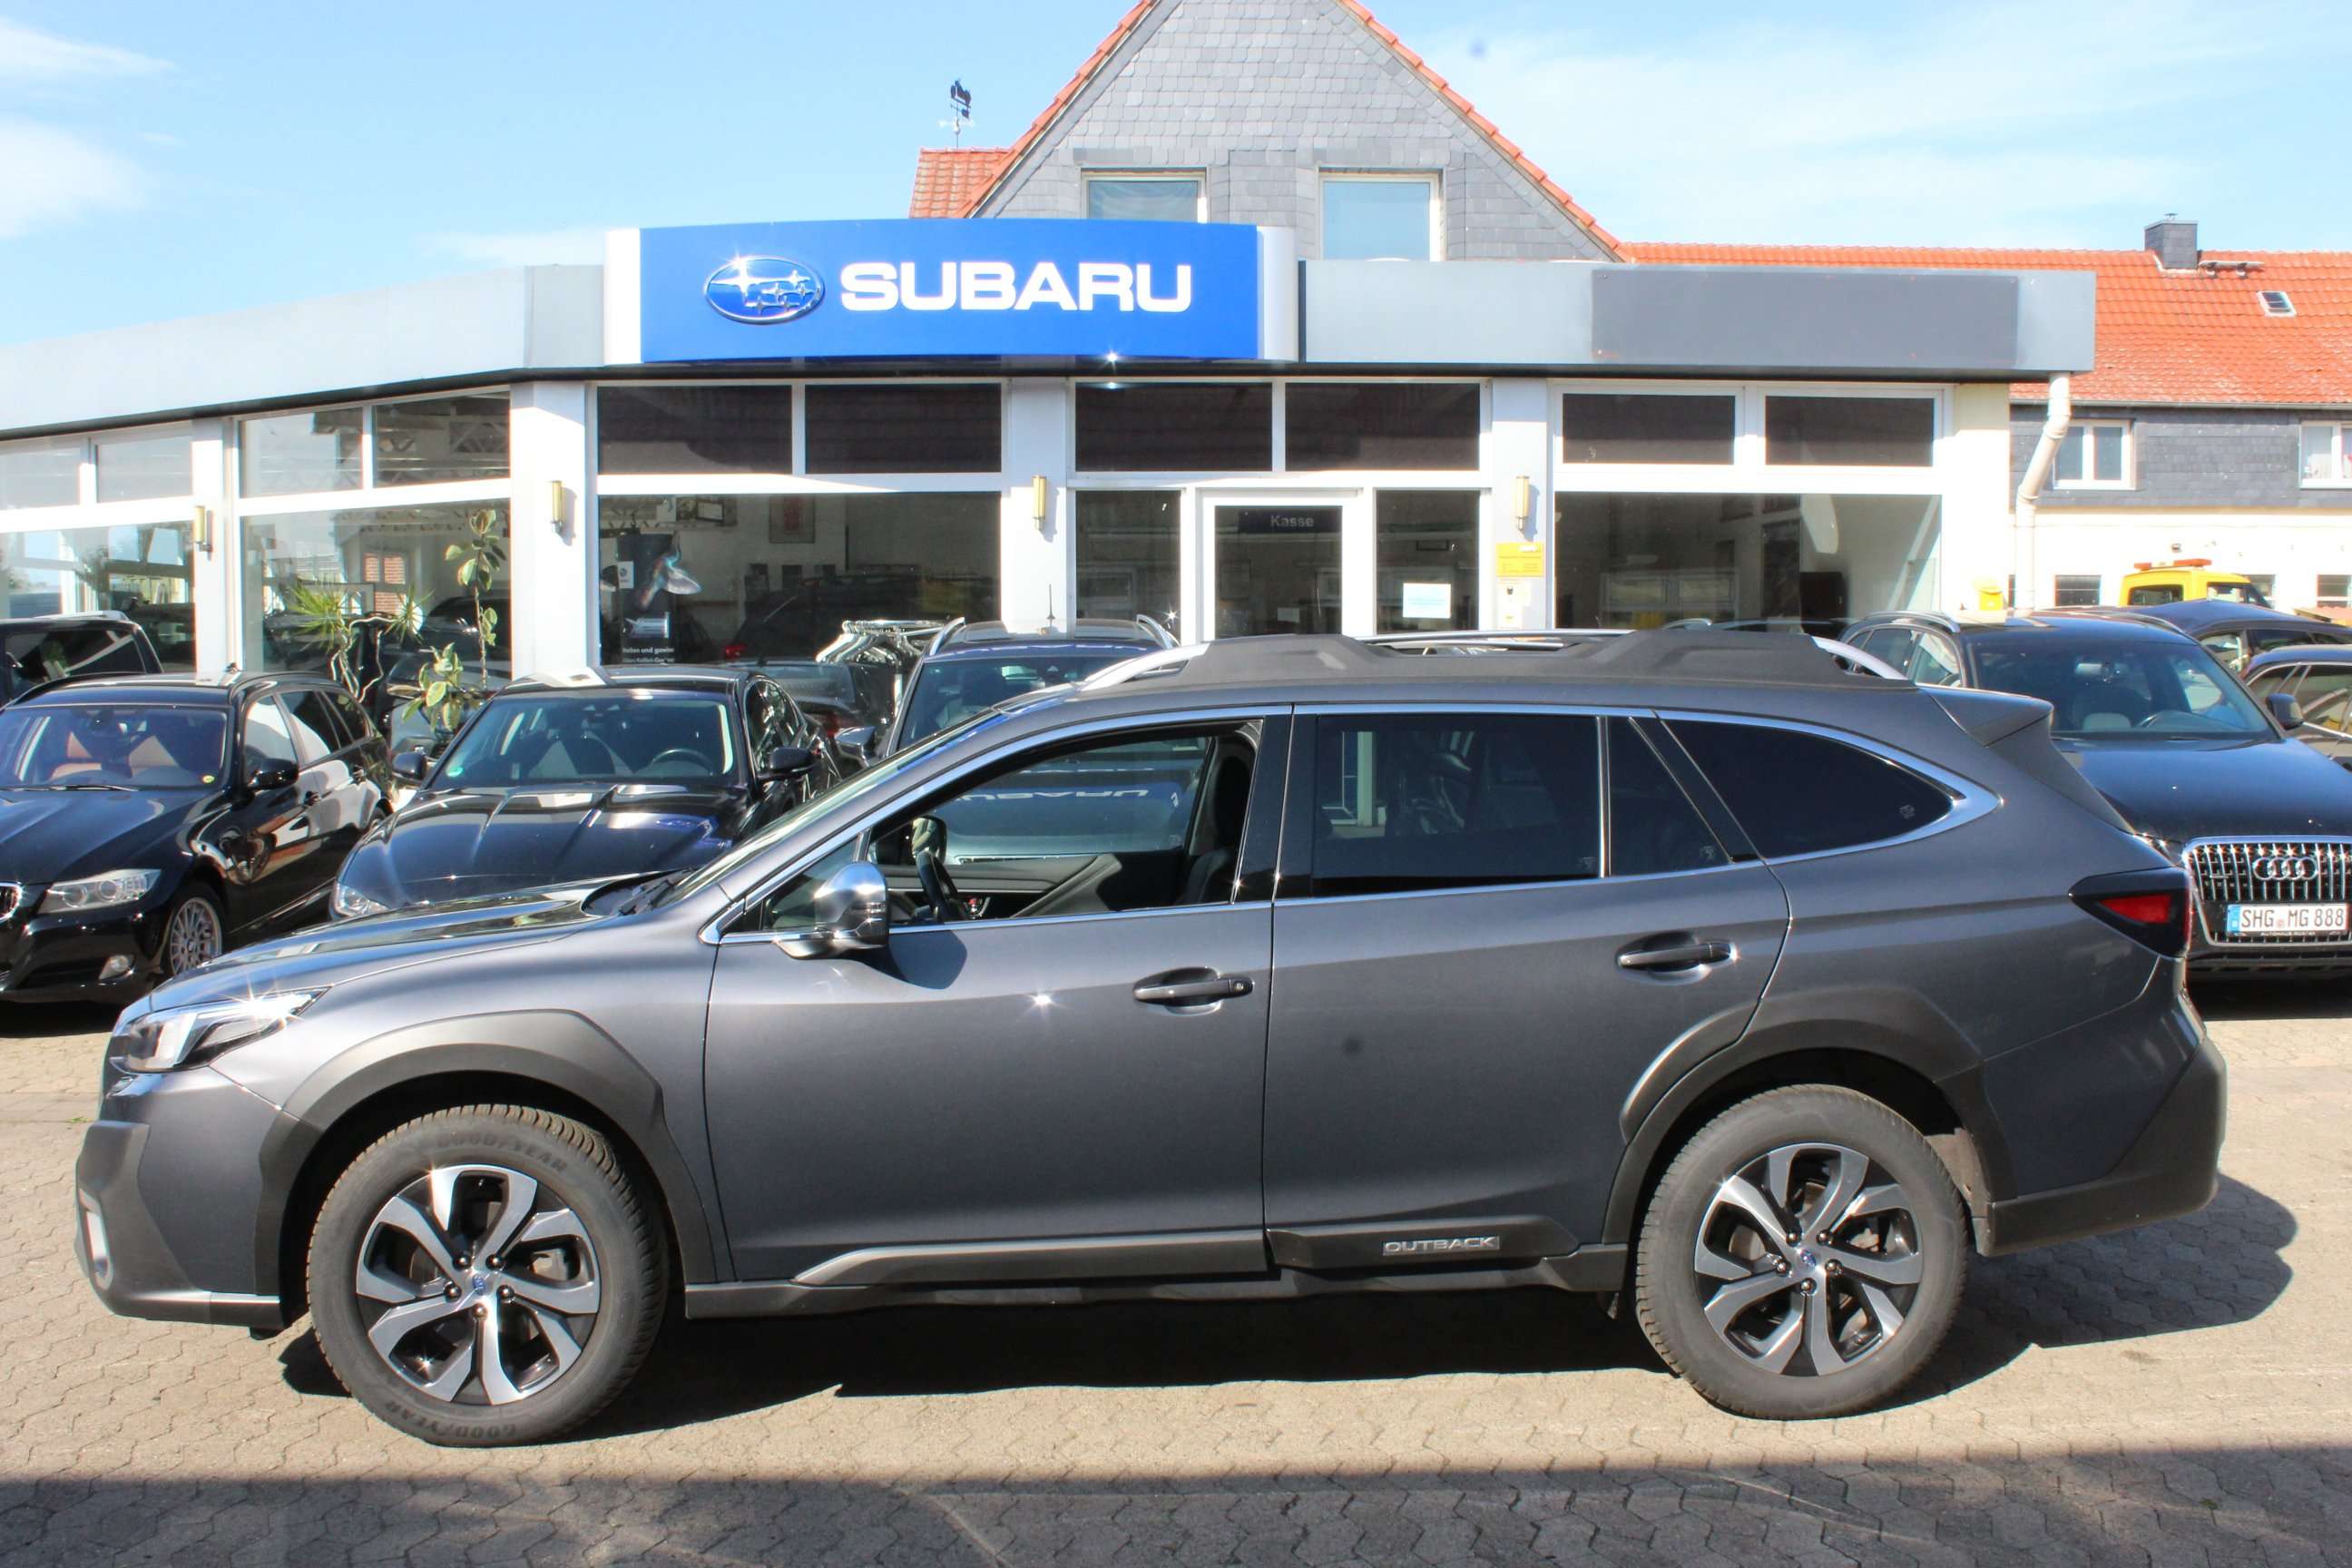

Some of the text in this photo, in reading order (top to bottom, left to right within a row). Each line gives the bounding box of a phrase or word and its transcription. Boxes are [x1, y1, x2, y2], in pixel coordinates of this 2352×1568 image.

[840, 261, 1191, 313] SUBARU
[1270, 514, 1314, 527] Kasse
[2241, 908, 2344, 928] SHG MG 888
[1385, 1237, 1496, 1252] OUTBACK
